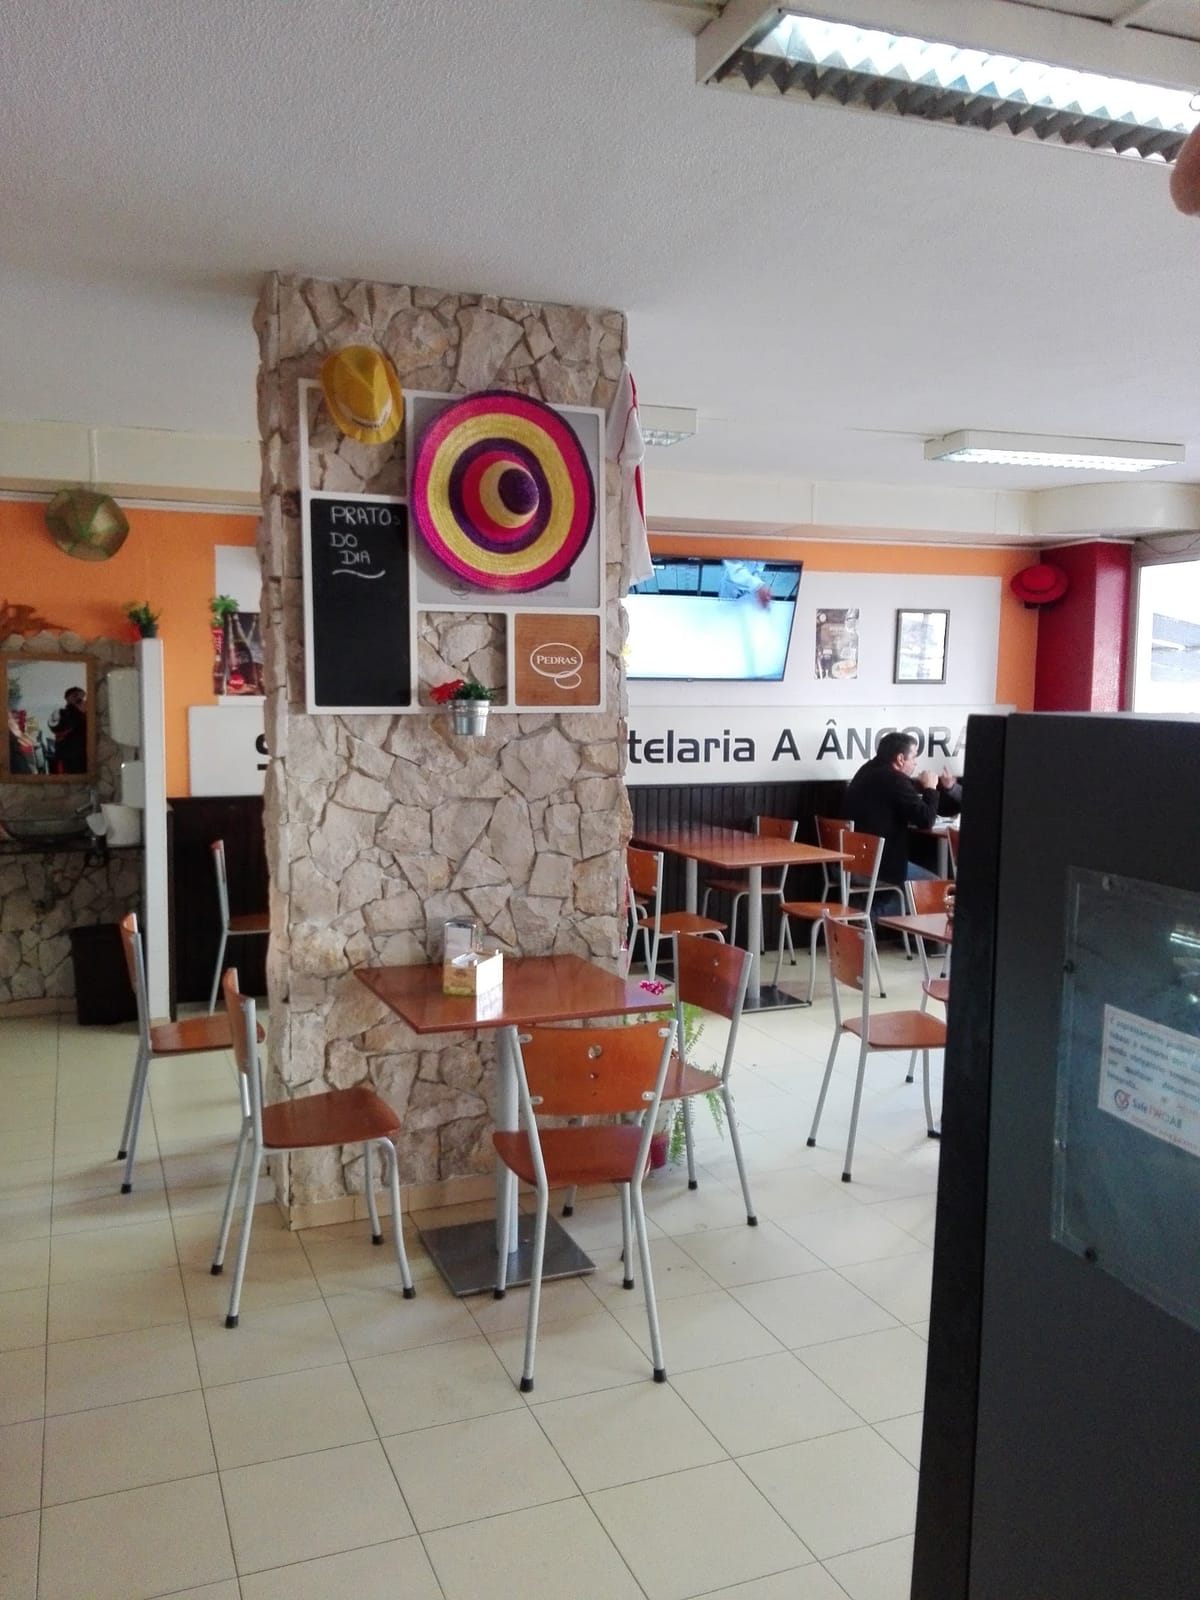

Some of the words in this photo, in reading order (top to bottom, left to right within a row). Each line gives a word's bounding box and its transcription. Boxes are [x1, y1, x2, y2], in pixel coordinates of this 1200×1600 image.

[329, 531, 359, 548] DO
[338, 549, 371, 565] DIA
[771, 729, 801, 762] A
